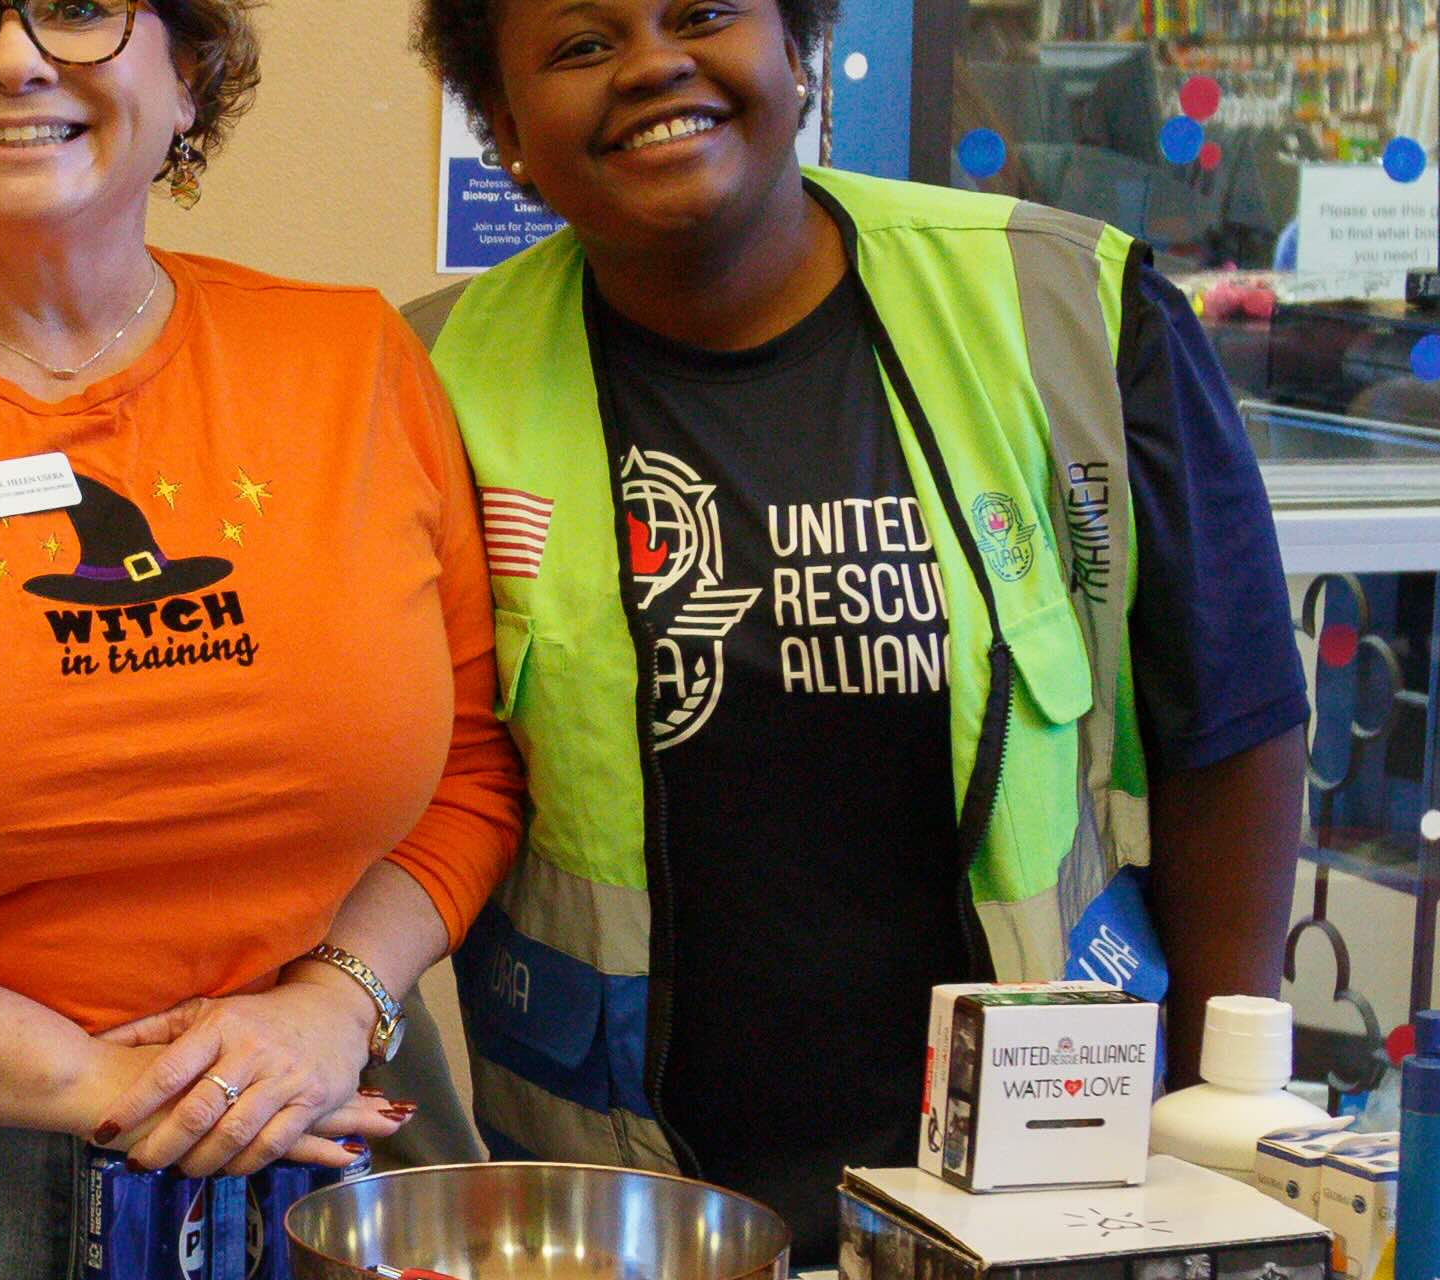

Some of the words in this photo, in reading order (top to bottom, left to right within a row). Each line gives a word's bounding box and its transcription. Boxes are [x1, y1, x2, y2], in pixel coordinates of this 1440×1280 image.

[1320, 204, 1367, 216] Please
[1372, 207, 1397, 216] use
[1402, 203, 1425, 216] this
[768, 496, 934, 557] UNITED
[44, 591, 245, 644] WITCH
[60, 648, 99, 677] in
[108, 631, 260, 675] training
[992, 1046, 1050, 1068] UNITED
[1079, 1044, 1146, 1065] ALLIANCE
[1003, 1078, 1063, 1100] WATTS
[1083, 1075, 1132, 1097] LOVE
